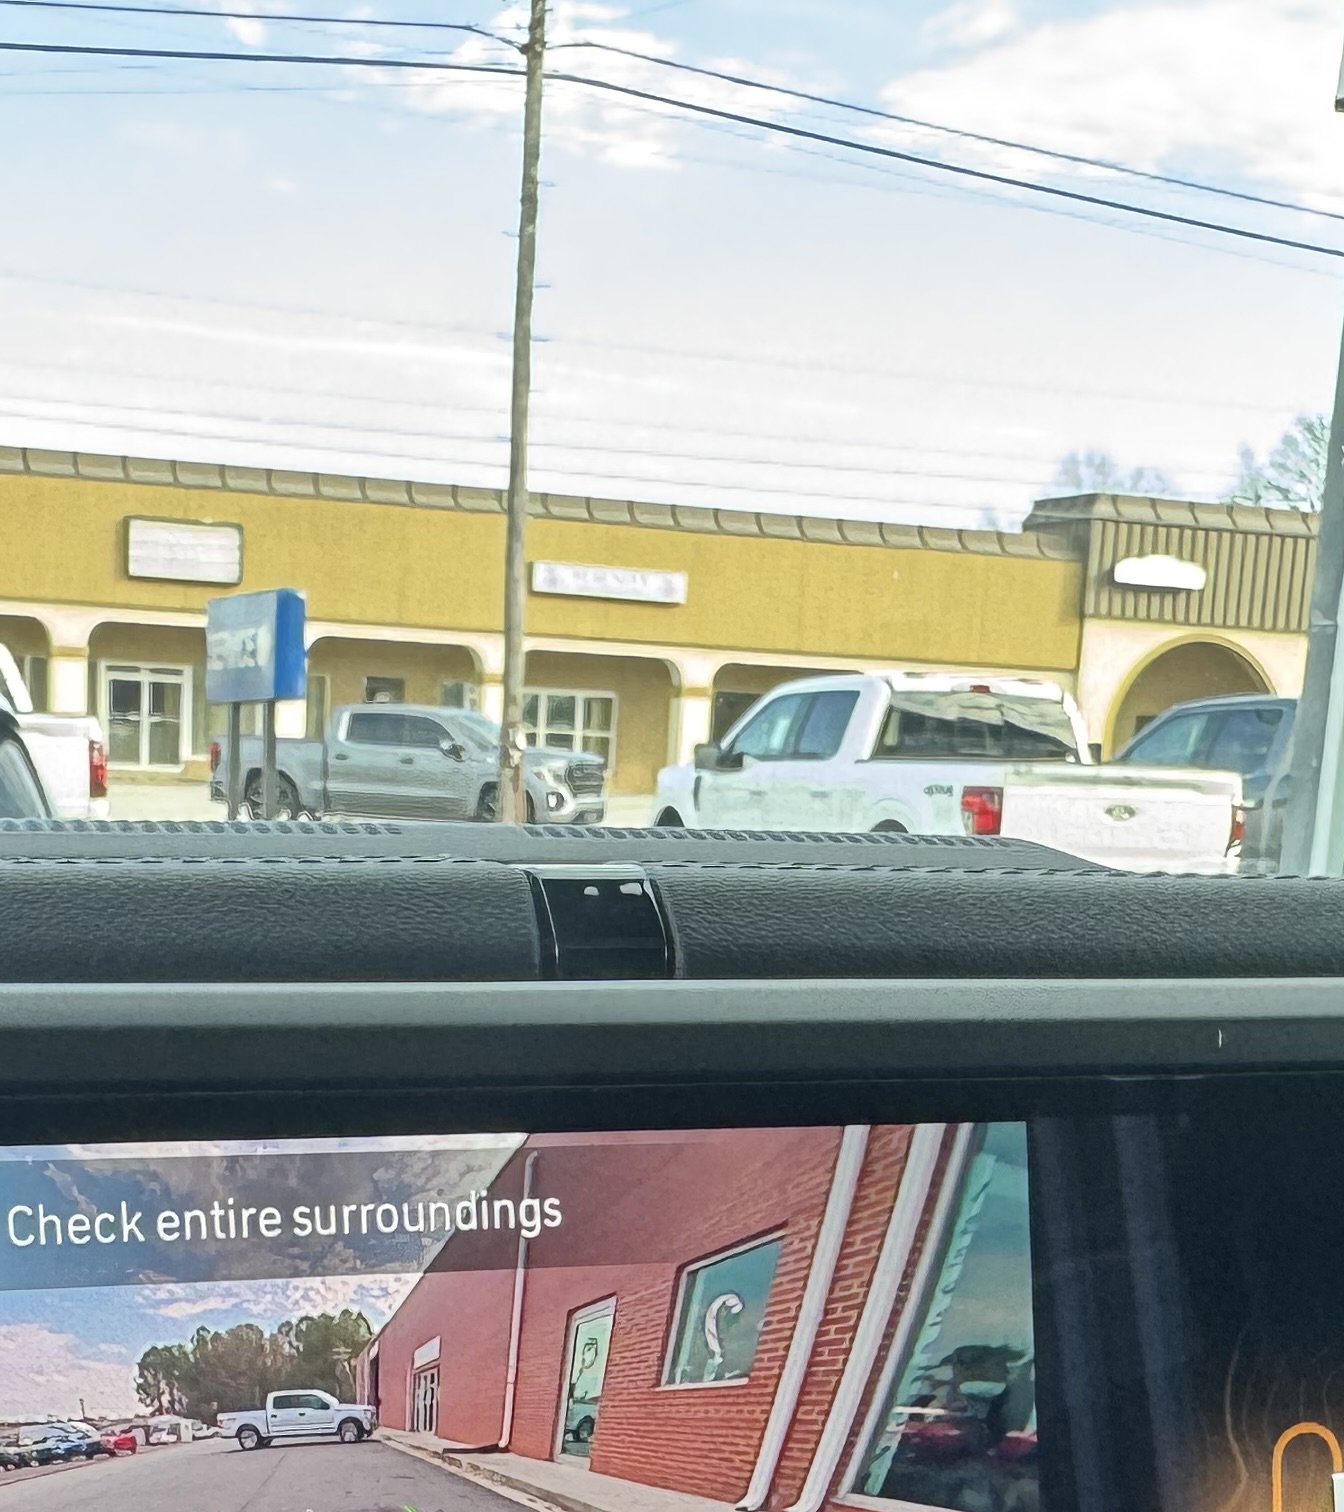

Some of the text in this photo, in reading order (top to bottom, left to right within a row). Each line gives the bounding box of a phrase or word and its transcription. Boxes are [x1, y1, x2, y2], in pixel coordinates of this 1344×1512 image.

[7, 1189, 563, 1247] Check entire surroundings
